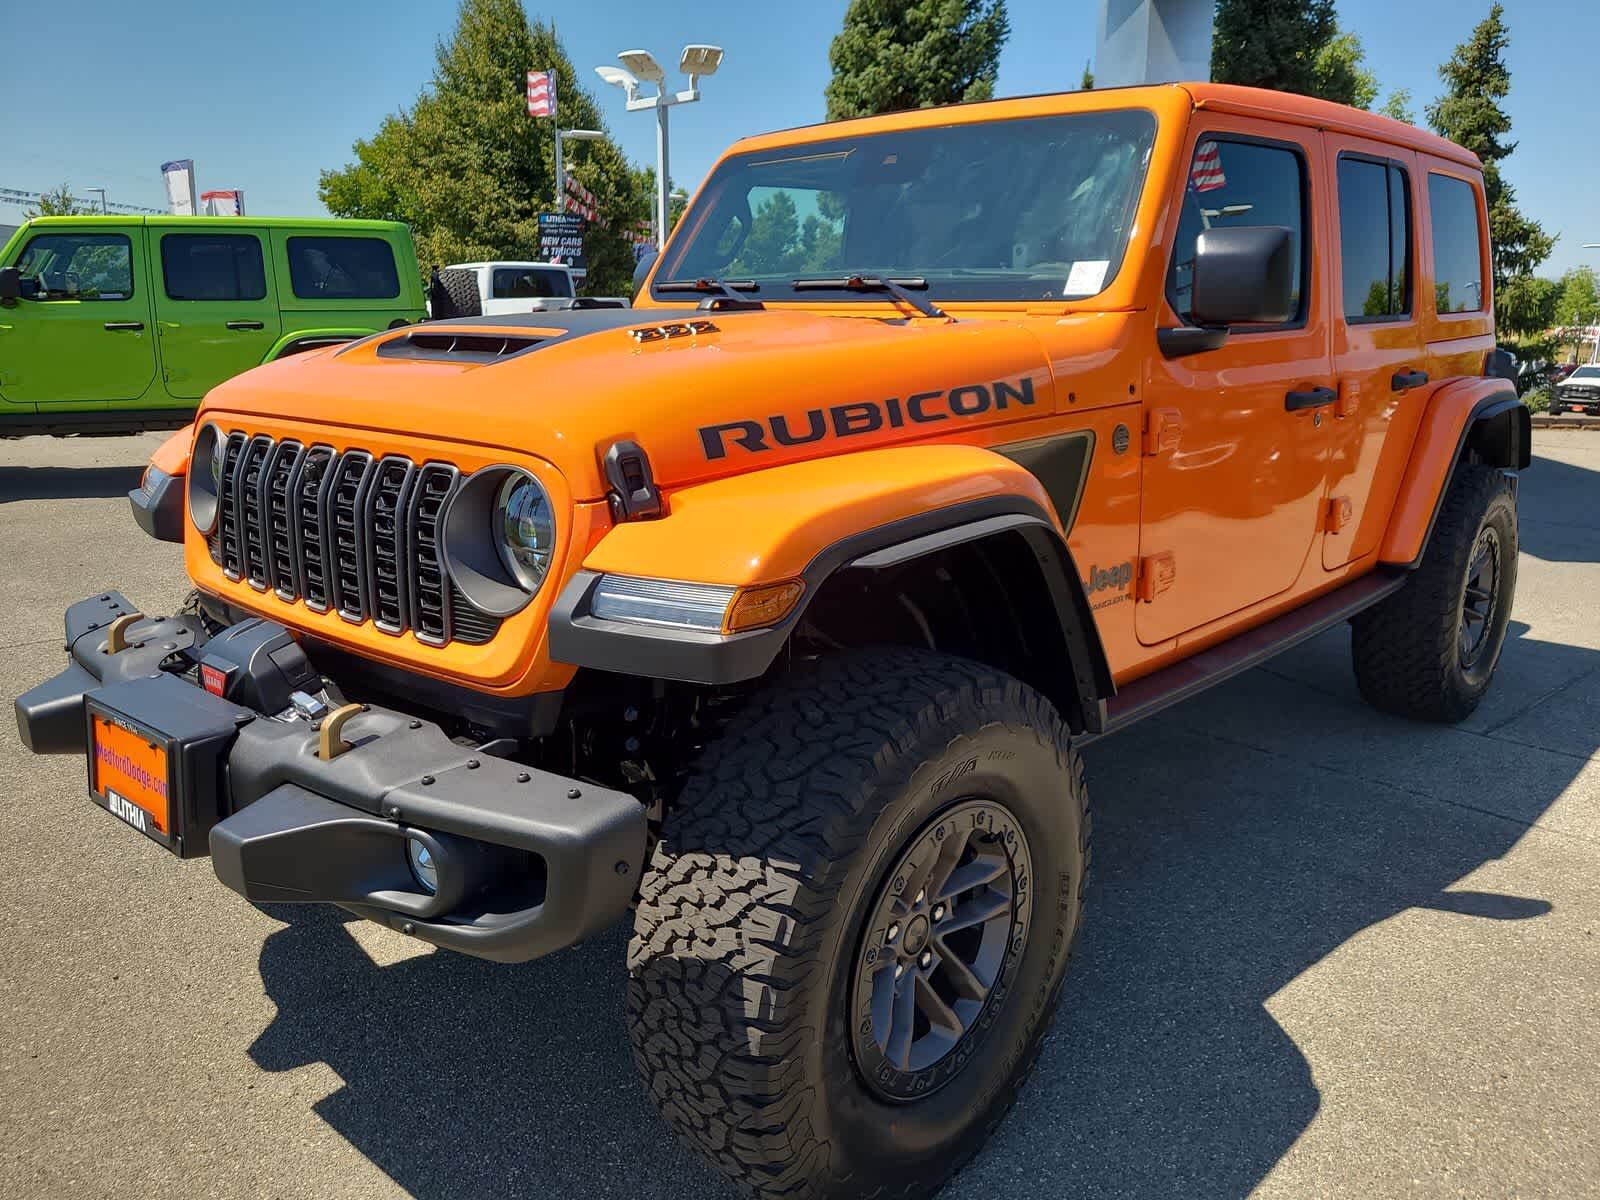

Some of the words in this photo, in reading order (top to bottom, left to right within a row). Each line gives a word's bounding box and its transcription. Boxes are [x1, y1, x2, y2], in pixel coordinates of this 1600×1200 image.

[541, 236, 560, 246] NEW
[561, 236, 583, 247] CARS
[542, 246, 549, 256] &
[551, 246, 582, 256] TRUCKS
[698, 376, 1036, 461] RUBICON
[1082, 561, 1133, 596] Jeep
[117, 797, 147, 832] LITHIA
